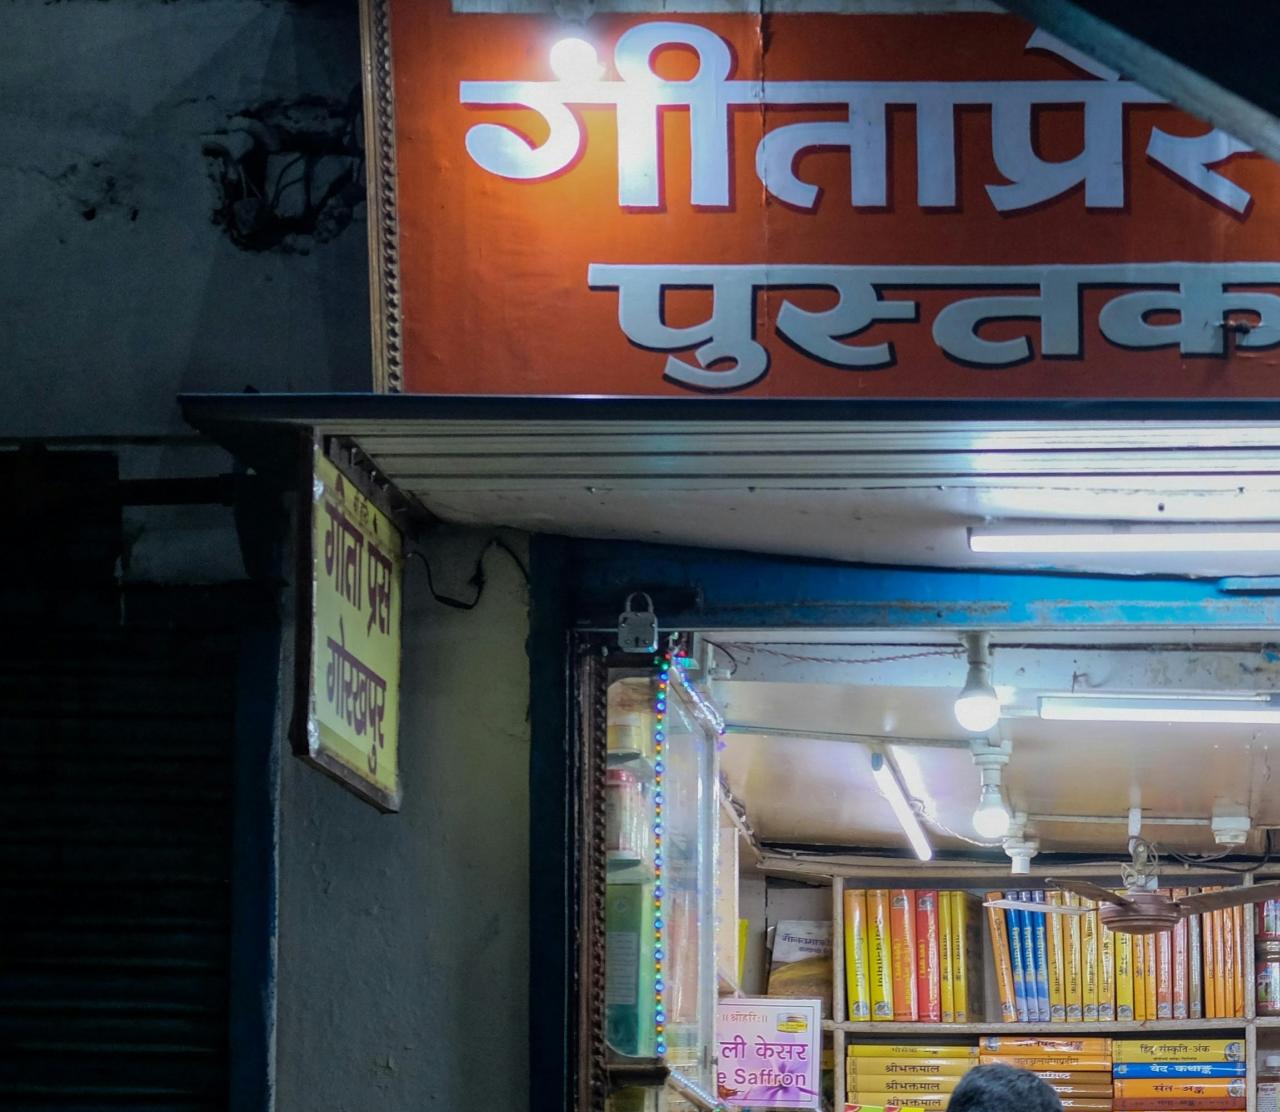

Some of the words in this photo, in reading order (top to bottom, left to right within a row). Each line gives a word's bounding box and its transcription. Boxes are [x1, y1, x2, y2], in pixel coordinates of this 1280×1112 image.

[326, 614, 387, 775] गोरखपुर
[719, 1034, 747, 1060] ली
[754, 1034, 809, 1061] केसर
[734, 1068, 807, 1087] Saffron
[885, 1063, 940, 1074] श्रीभक्तमाल
[885, 1080, 941, 1091] श्रीभक्तमाल
